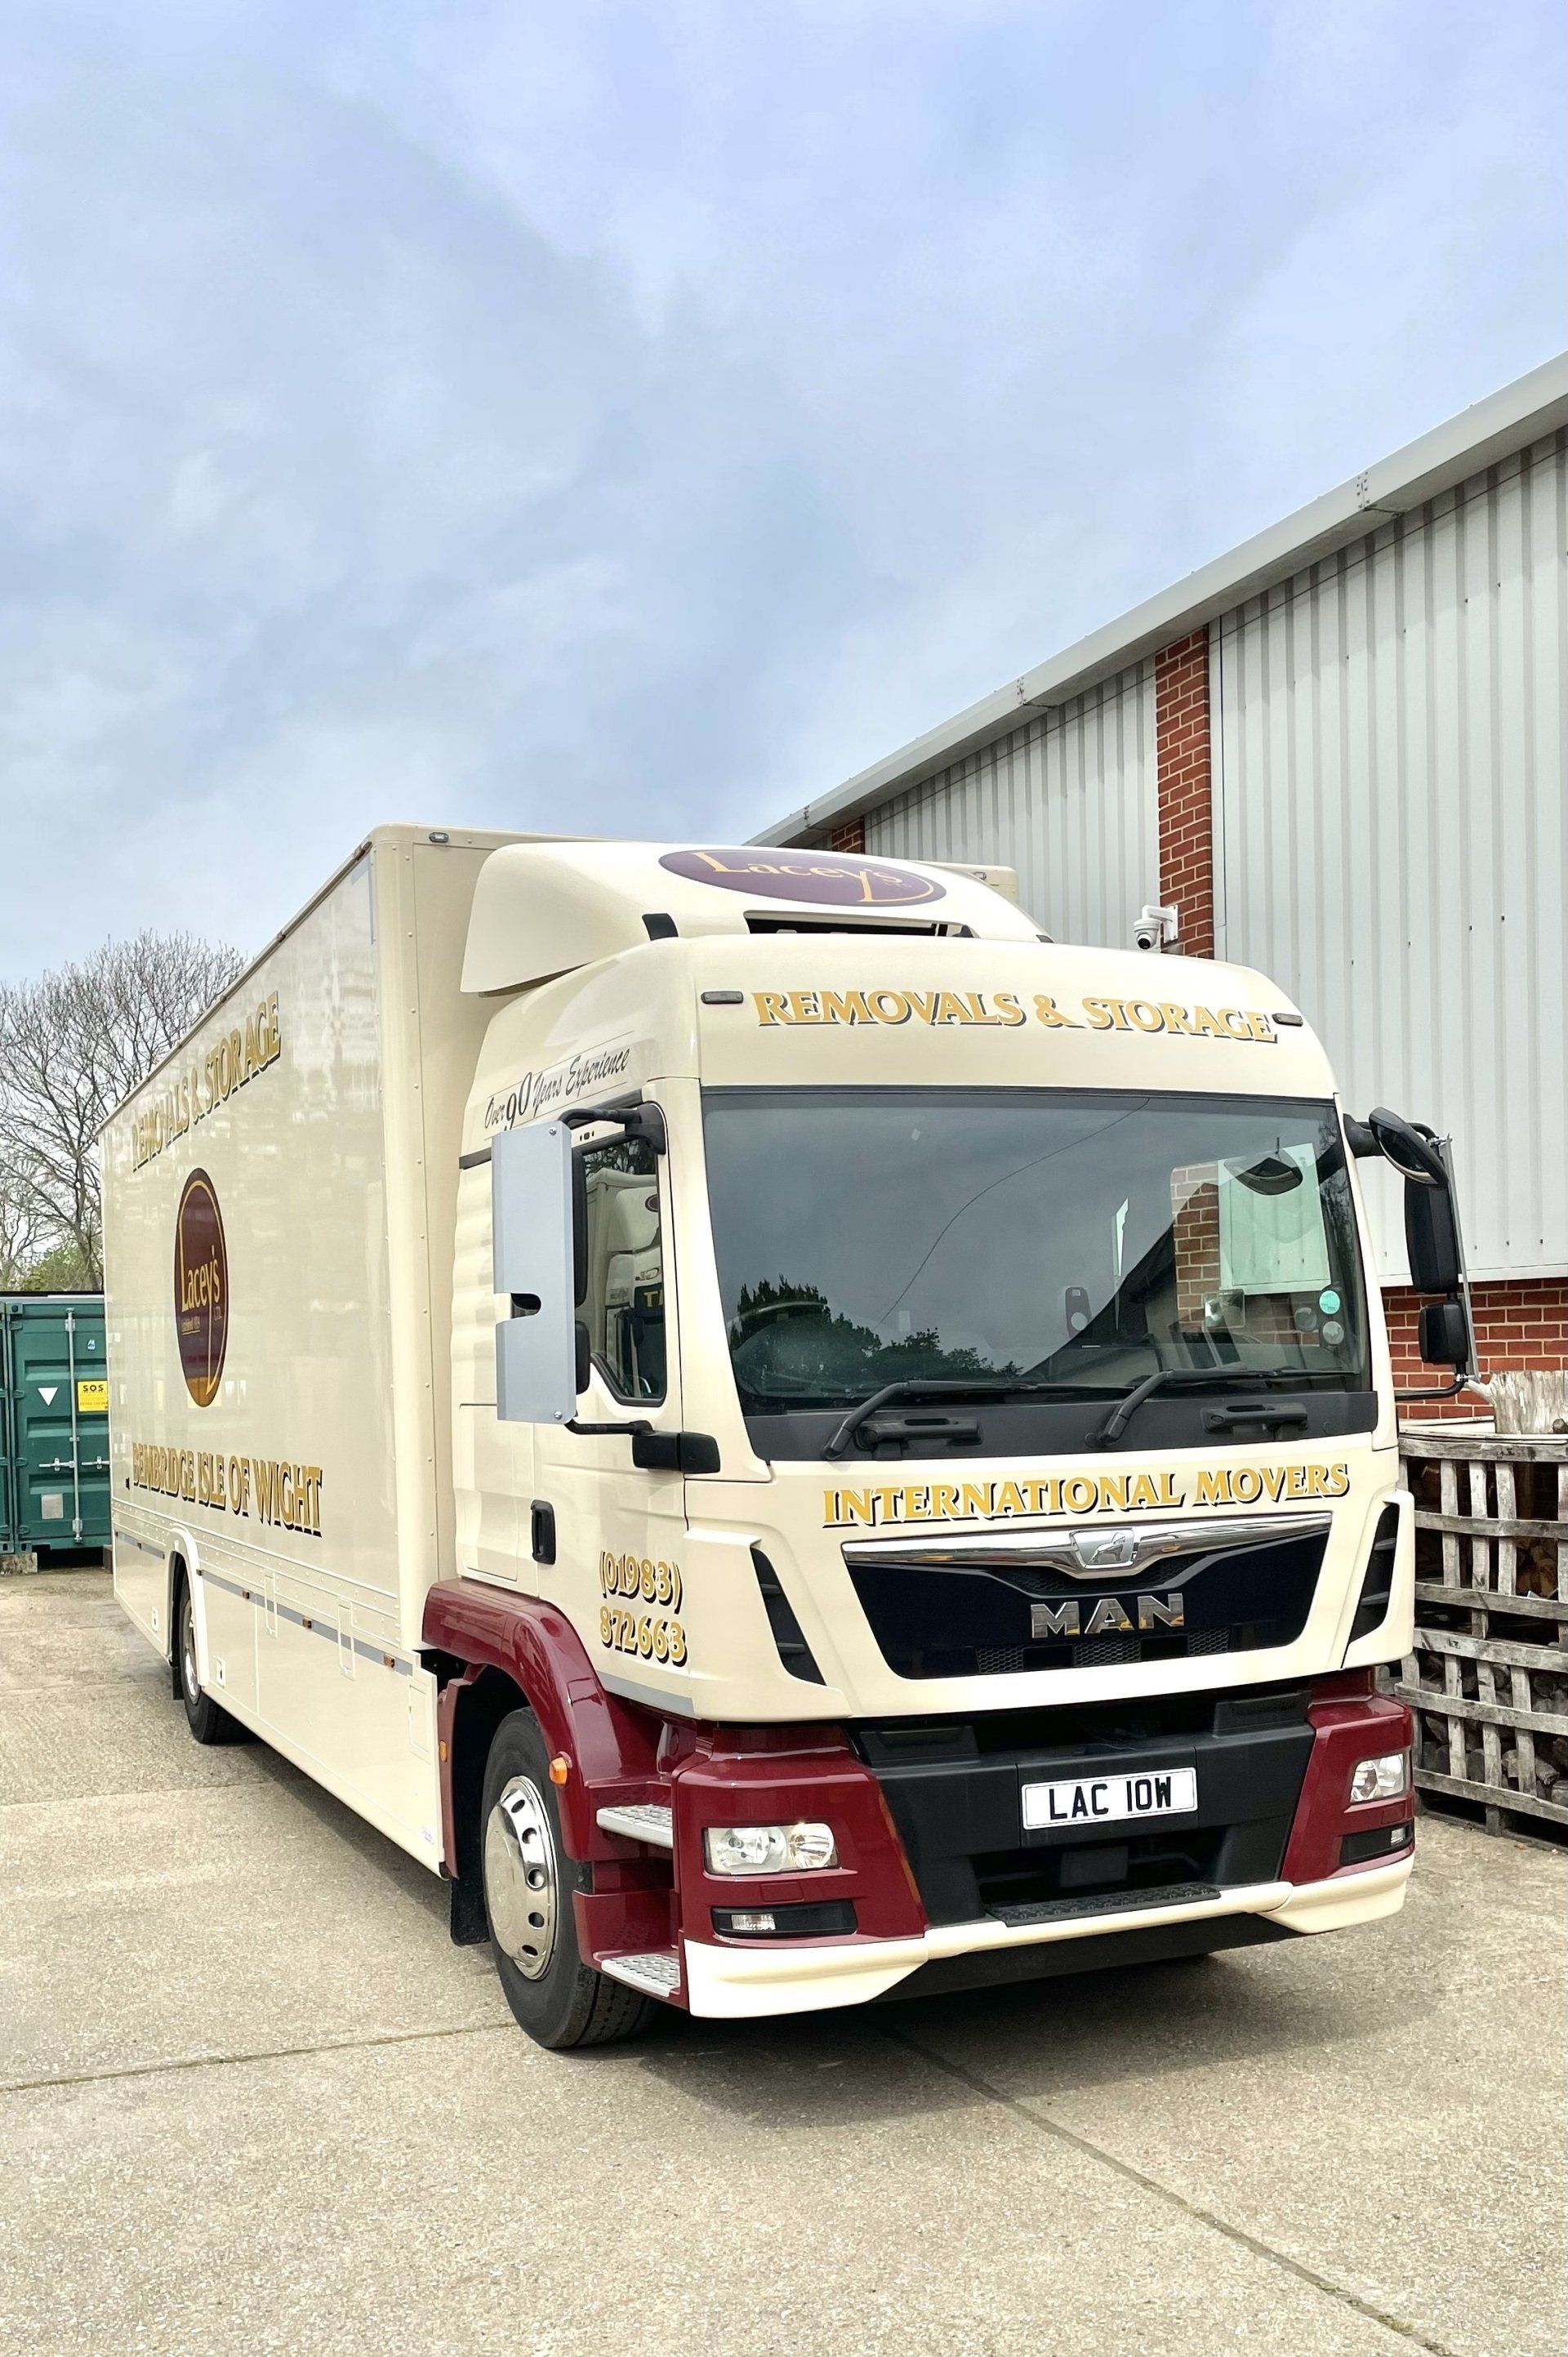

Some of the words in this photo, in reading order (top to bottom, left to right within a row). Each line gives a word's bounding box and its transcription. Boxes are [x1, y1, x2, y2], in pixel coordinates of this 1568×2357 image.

[695, 851, 903, 902] Lacey's
[751, 991, 1027, 1027] REMOVALS
[1033, 994, 1087, 1028] &
[1081, 997, 1278, 1044] STORAGE
[131, 1075, 189, 1173] REMOVALS
[190, 1067, 206, 1125] &
[203, 990, 281, 1115] STORAGE
[485, 1097, 505, 1129] Over
[504, 1072, 532, 1131] 90
[532, 1072, 562, 1119] Years
[565, 1048, 630, 1098] Experience
[82, 1383, 104, 1393] SOS
[132, 1442, 195, 1503] BEMBRIDGE
[197, 1451, 226, 1511] ISLE
[229, 1455, 250, 1517] OF
[252, 1458, 323, 1538] WIGHT
[822, 1473, 1186, 1528] INTERNATIONAL
[1192, 1464, 1350, 1507] MOVERS
[599, 1549, 683, 1615] (01983)
[599, 1606, 688, 1668] 872663
[1030, 1593, 1184, 1638] MAN
[1049, 1784, 1109, 1820] LAC
